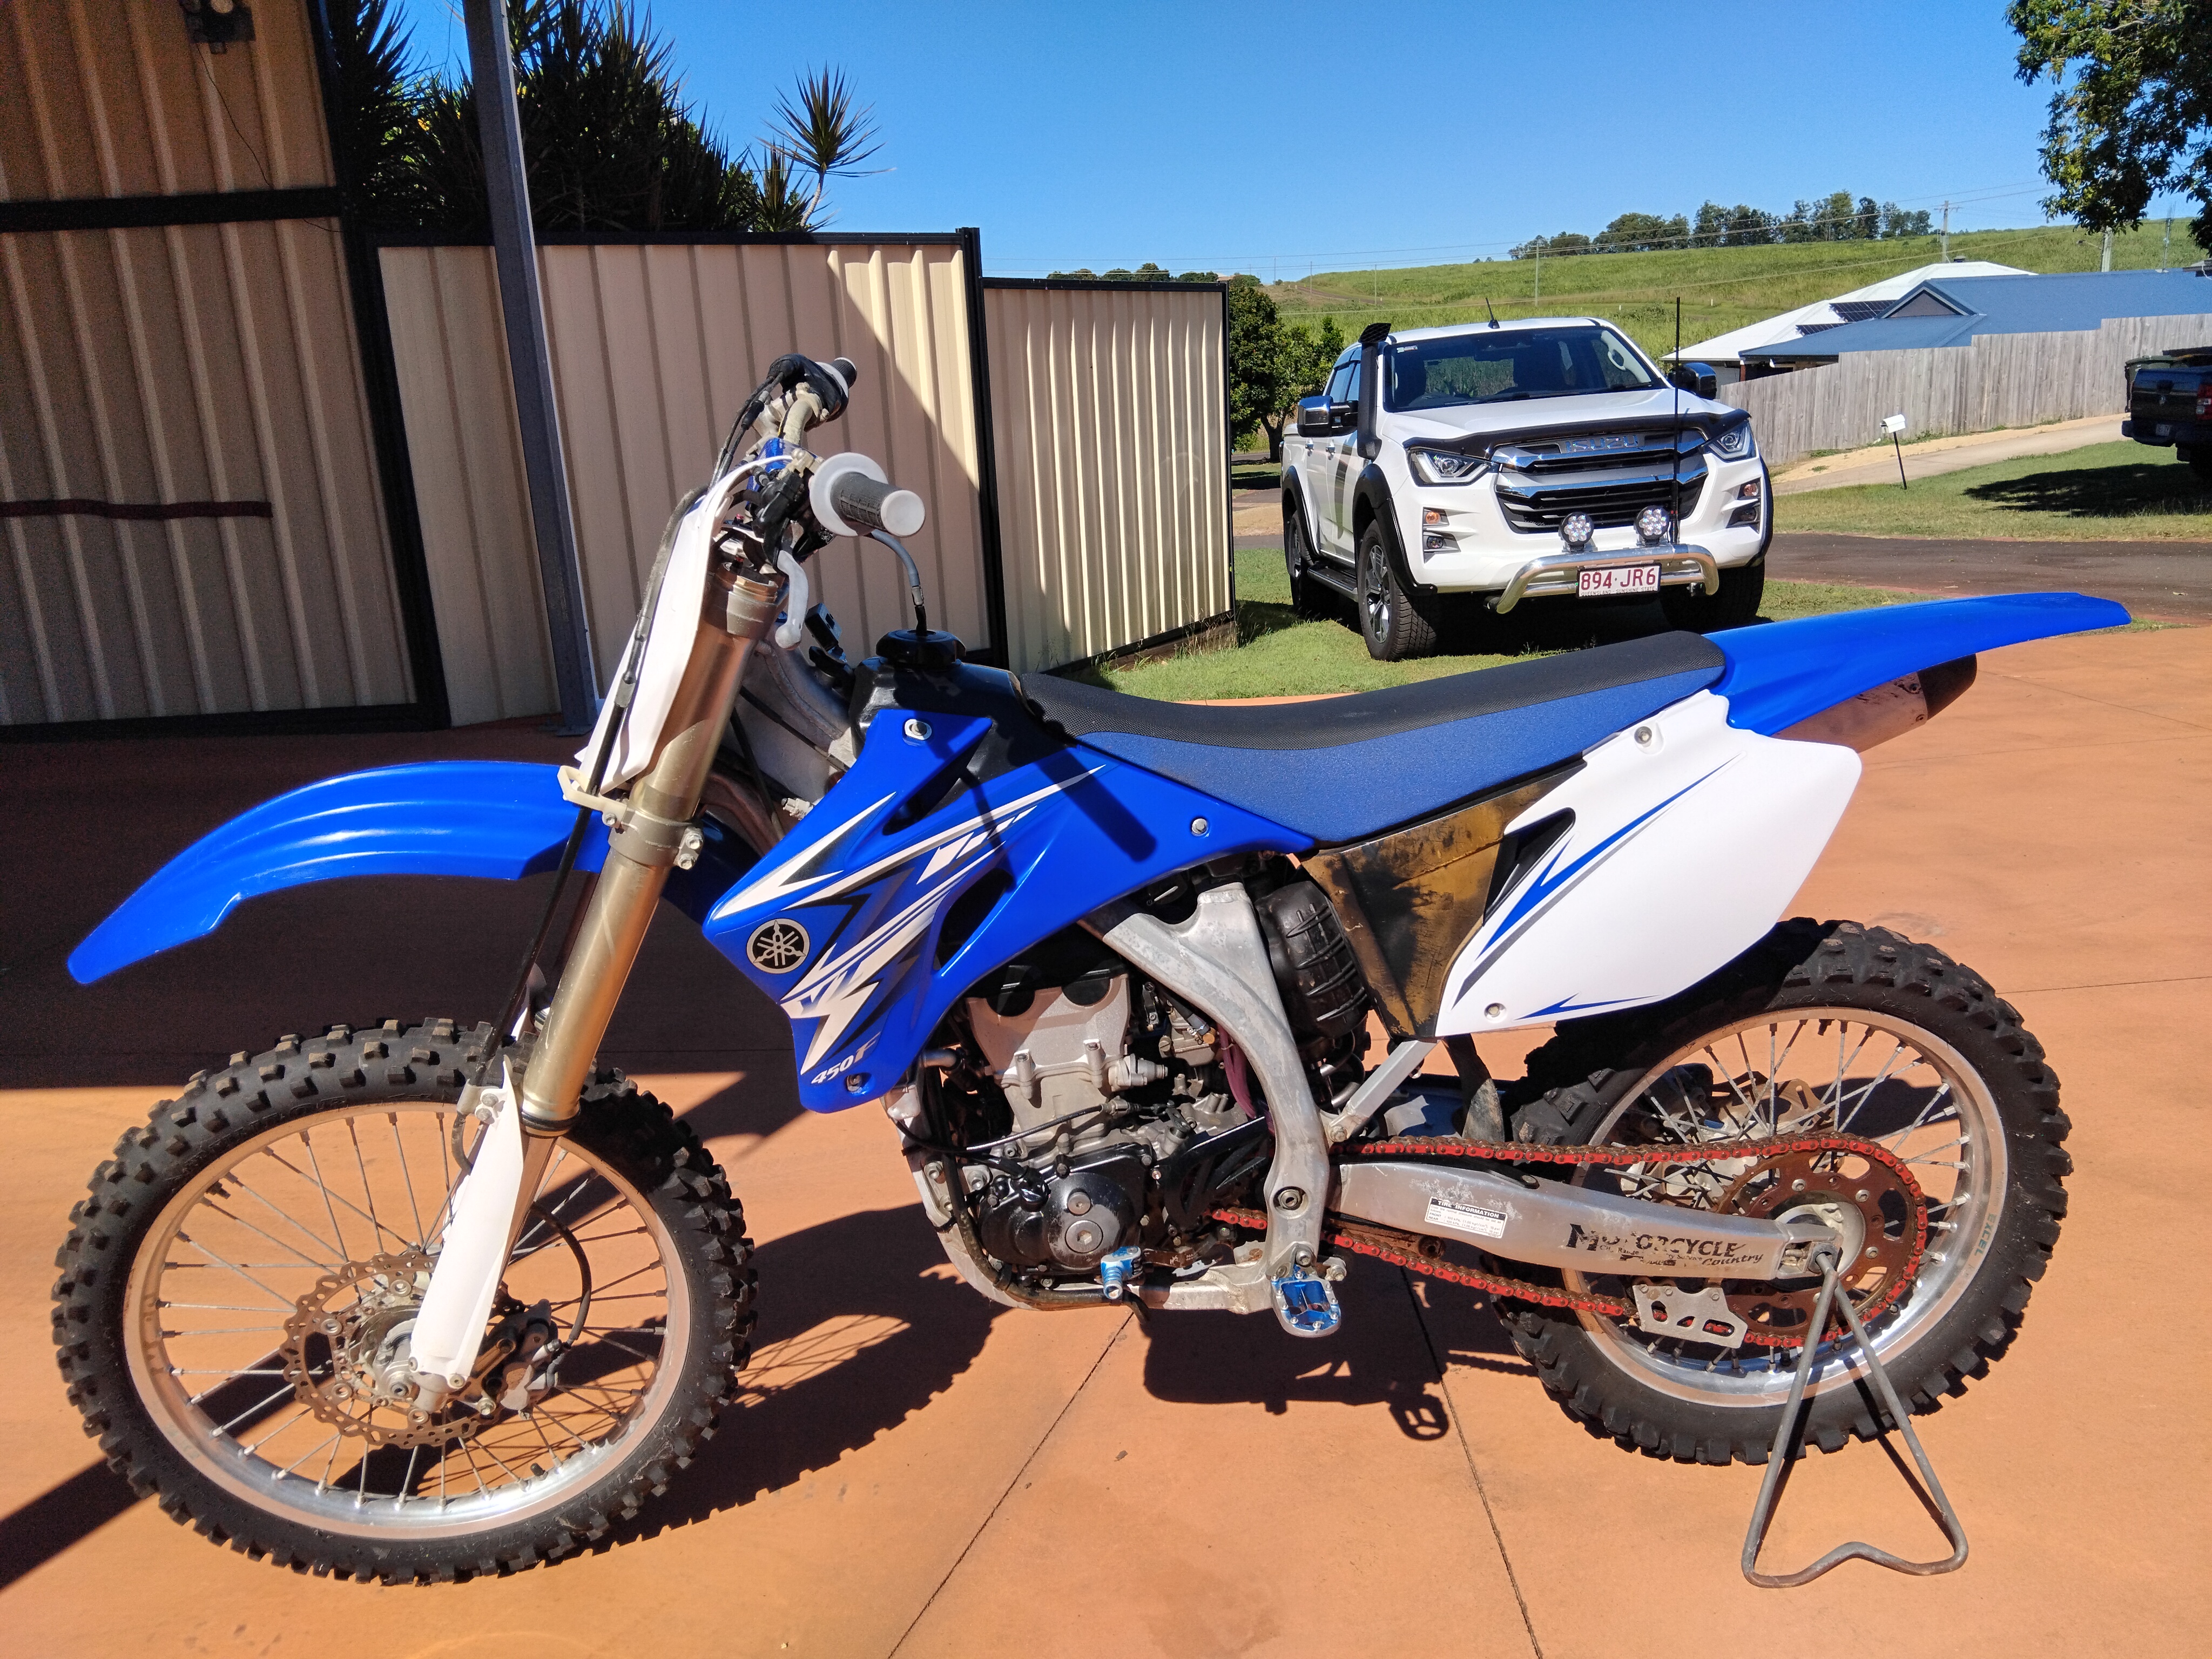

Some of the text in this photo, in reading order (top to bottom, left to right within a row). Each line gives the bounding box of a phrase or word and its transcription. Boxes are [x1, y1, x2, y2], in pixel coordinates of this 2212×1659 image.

[1566, 435, 1638, 453] ISUZU
[1581, 568, 1656, 590] 894 JR6
[811, 1031, 881, 1084] 450F
[1455, 1204, 1499, 1218] INFORMATION
[1974, 1213, 1997, 1256] EXCEL
[1702, 1254, 1763, 1266] Country
